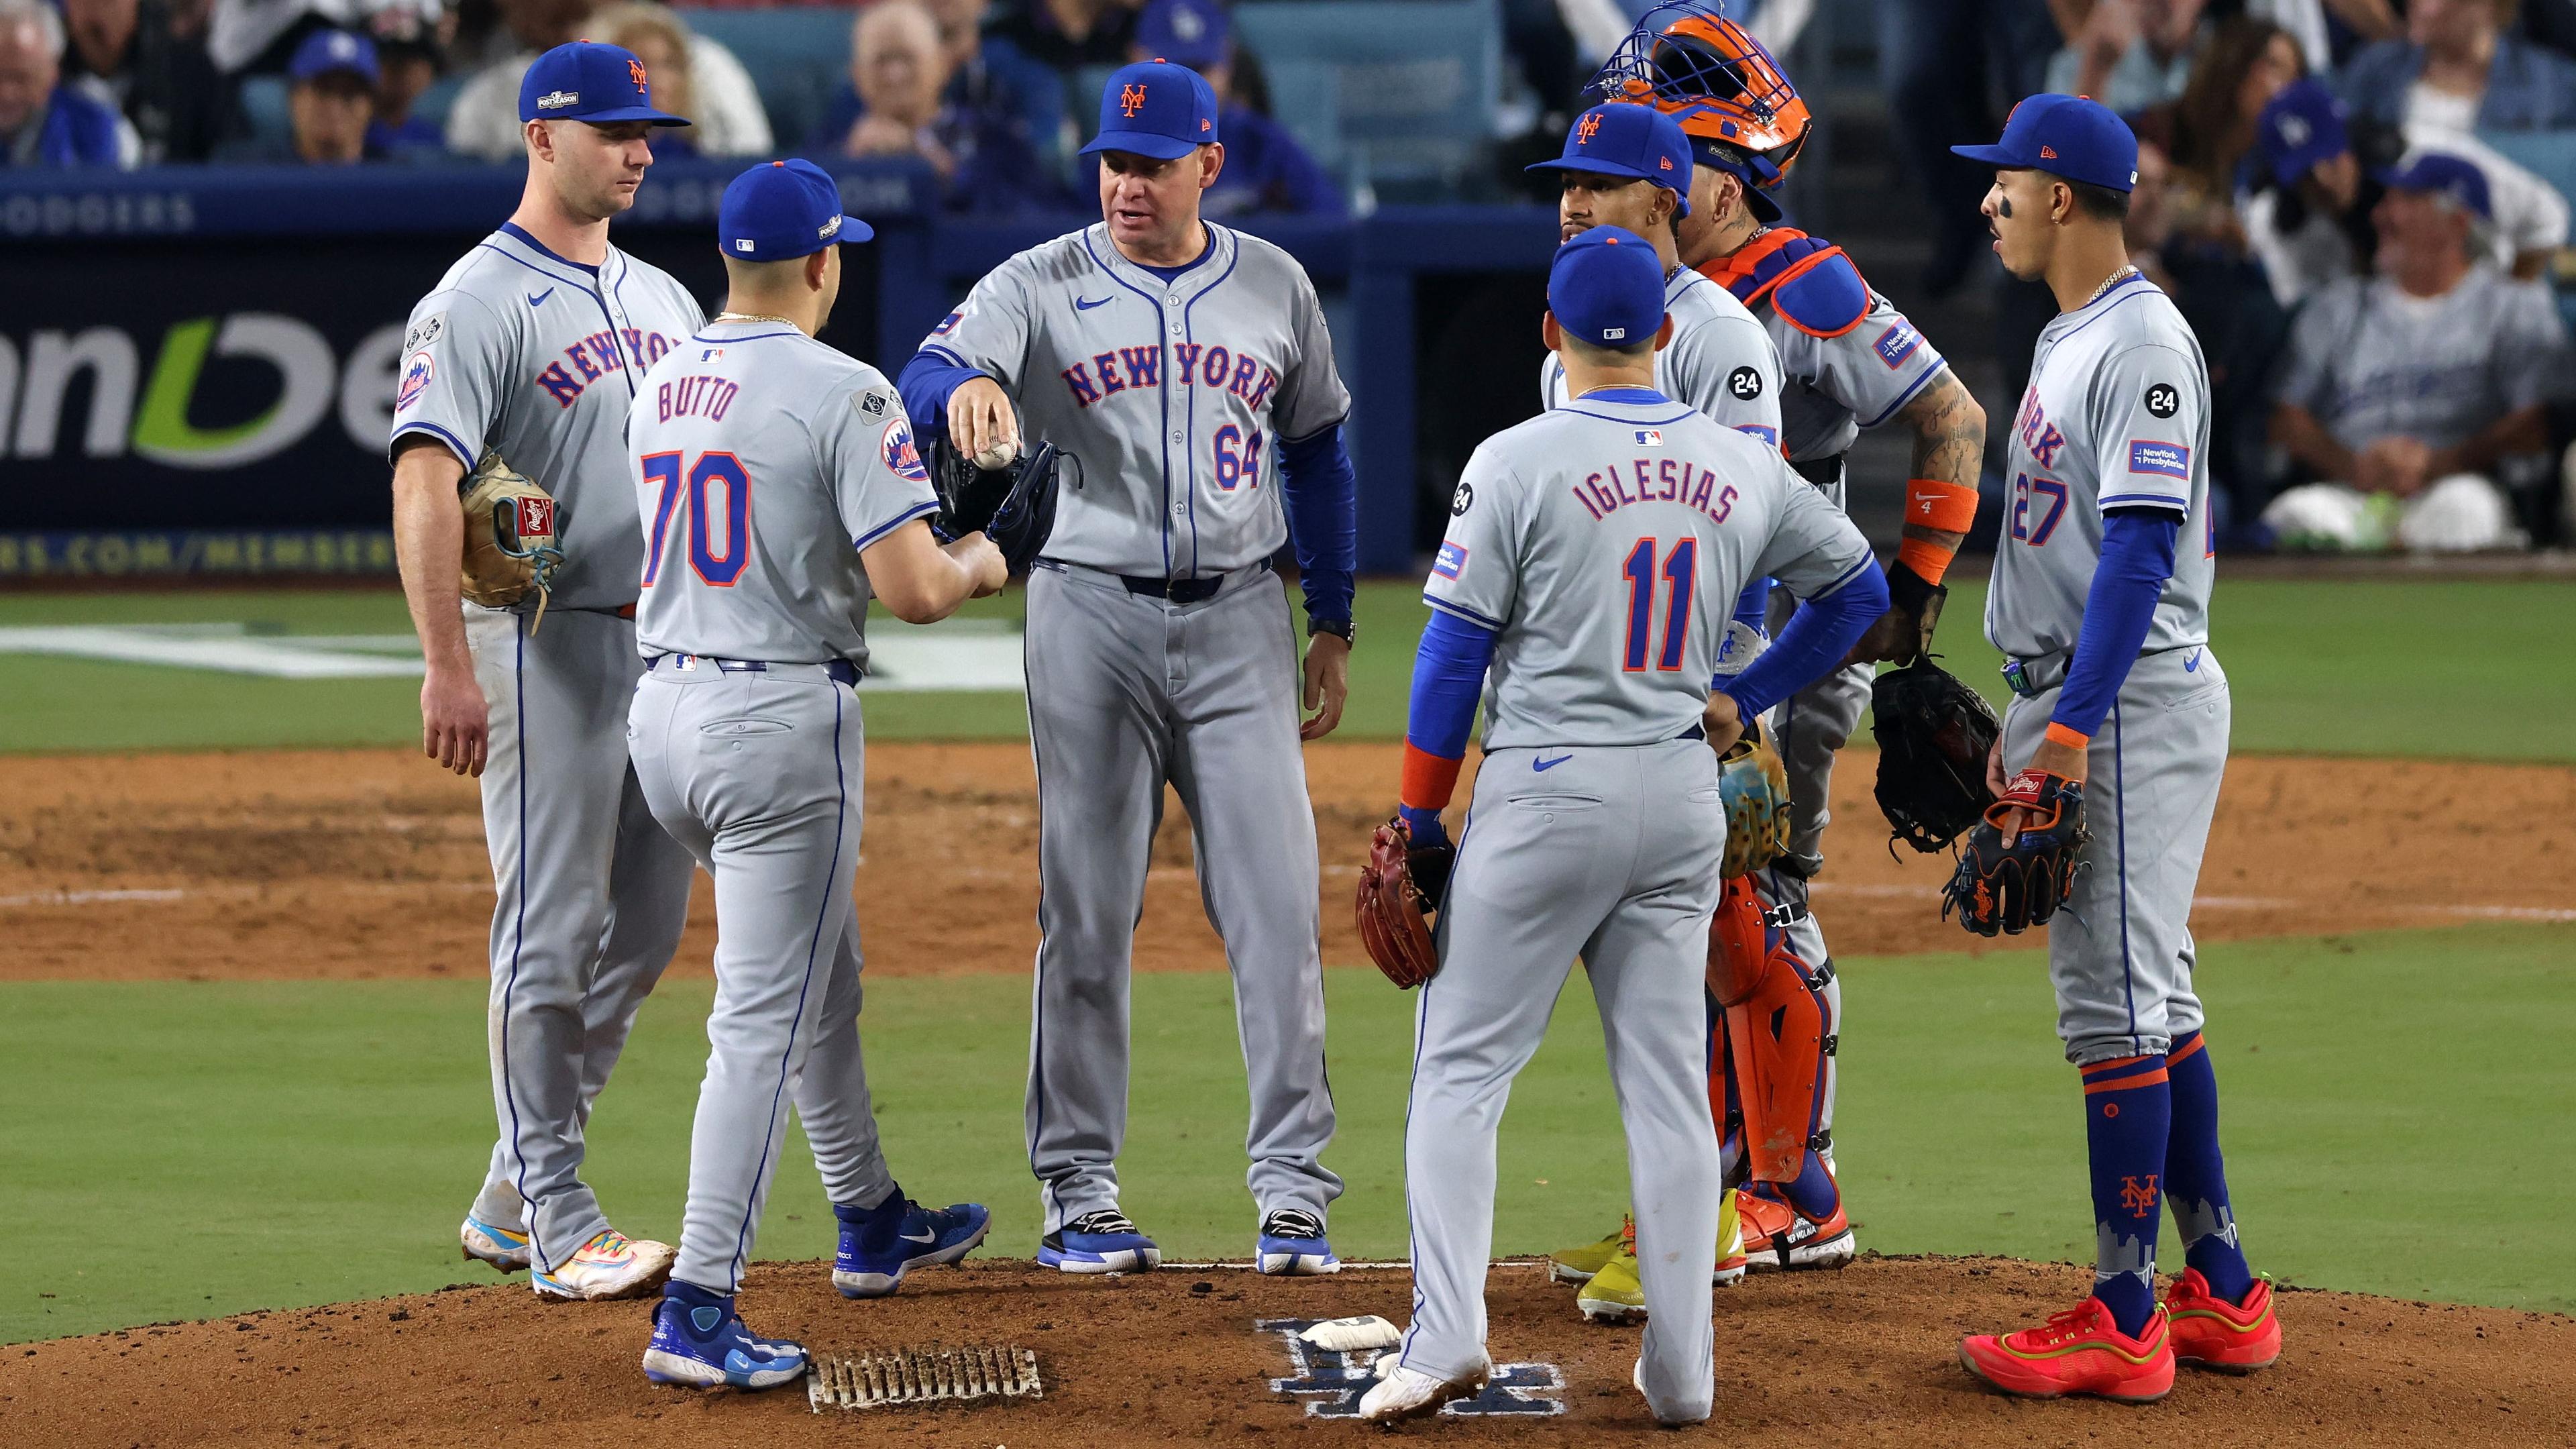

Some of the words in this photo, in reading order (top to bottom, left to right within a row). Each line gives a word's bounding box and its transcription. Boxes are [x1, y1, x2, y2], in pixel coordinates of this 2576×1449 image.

[539, 95, 577, 108] POSTSEASON
[1120, 84, 1148, 118] NY
[1577, 113, 1605, 145] NY
[0, 195, 195, 235] ODGERS
[536, 330, 623, 409] NEW
[620, 328, 683, 367] YO
[1061, 345, 1161, 408] NEW
[1174, 342, 1276, 413] YORK
[1734, 372, 1759, 394] 24
[659, 375, 739, 425] BUTTO
[865, 393, 883, 414] 3
[2151, 390, 2176, 412] 24
[1214, 423, 1263, 491] 64
[2143, 448, 2179, 460] NewYork-
[2143, 456, 2186, 471] Presbyterian
[1453, 488, 1471, 512] 24
[1572, 459, 1739, 525] IGLESIAS
[1921, 500, 1931, 515] 4
[2012, 472, 2069, 547] 27
[640, 450, 751, 587] 70
[1622, 536, 1697, 672] 11
[2121, 1174, 2158, 1218] NY
